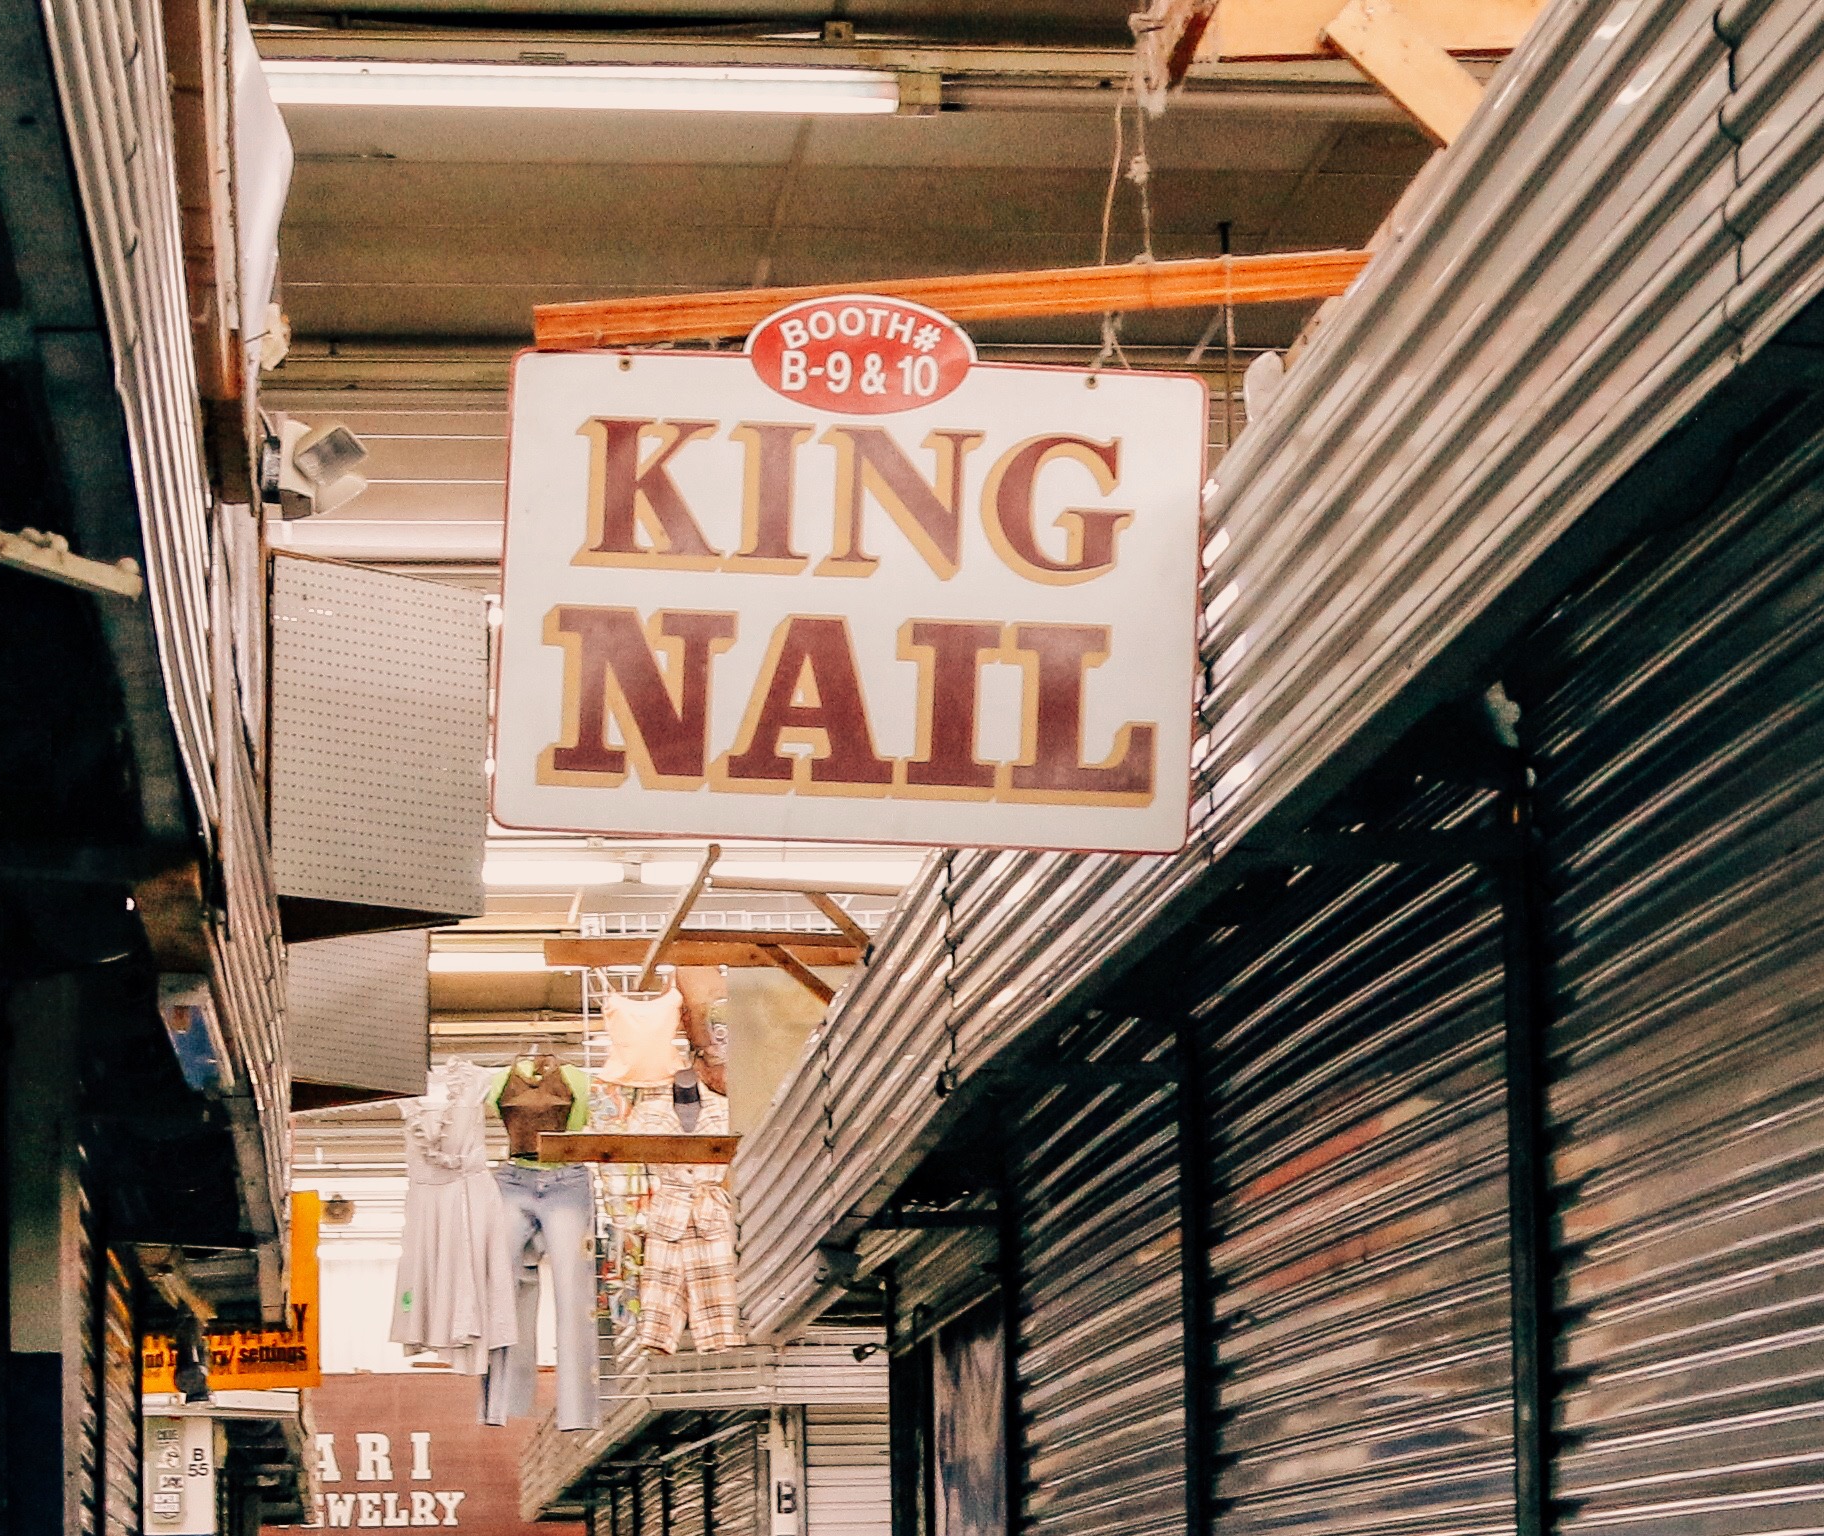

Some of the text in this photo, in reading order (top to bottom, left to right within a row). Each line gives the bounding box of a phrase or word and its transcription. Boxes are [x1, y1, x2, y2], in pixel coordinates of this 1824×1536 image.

[779, 306, 942, 353] BOOTH#
[780, 350, 940, 397] B-9 & 10
[571, 417, 1134, 586] KING
[536, 604, 1159, 808] NAIL
[187, 1462, 210, 1477] 55
[193, 1447, 205, 1462] B
[776, 1480, 797, 1514] B
